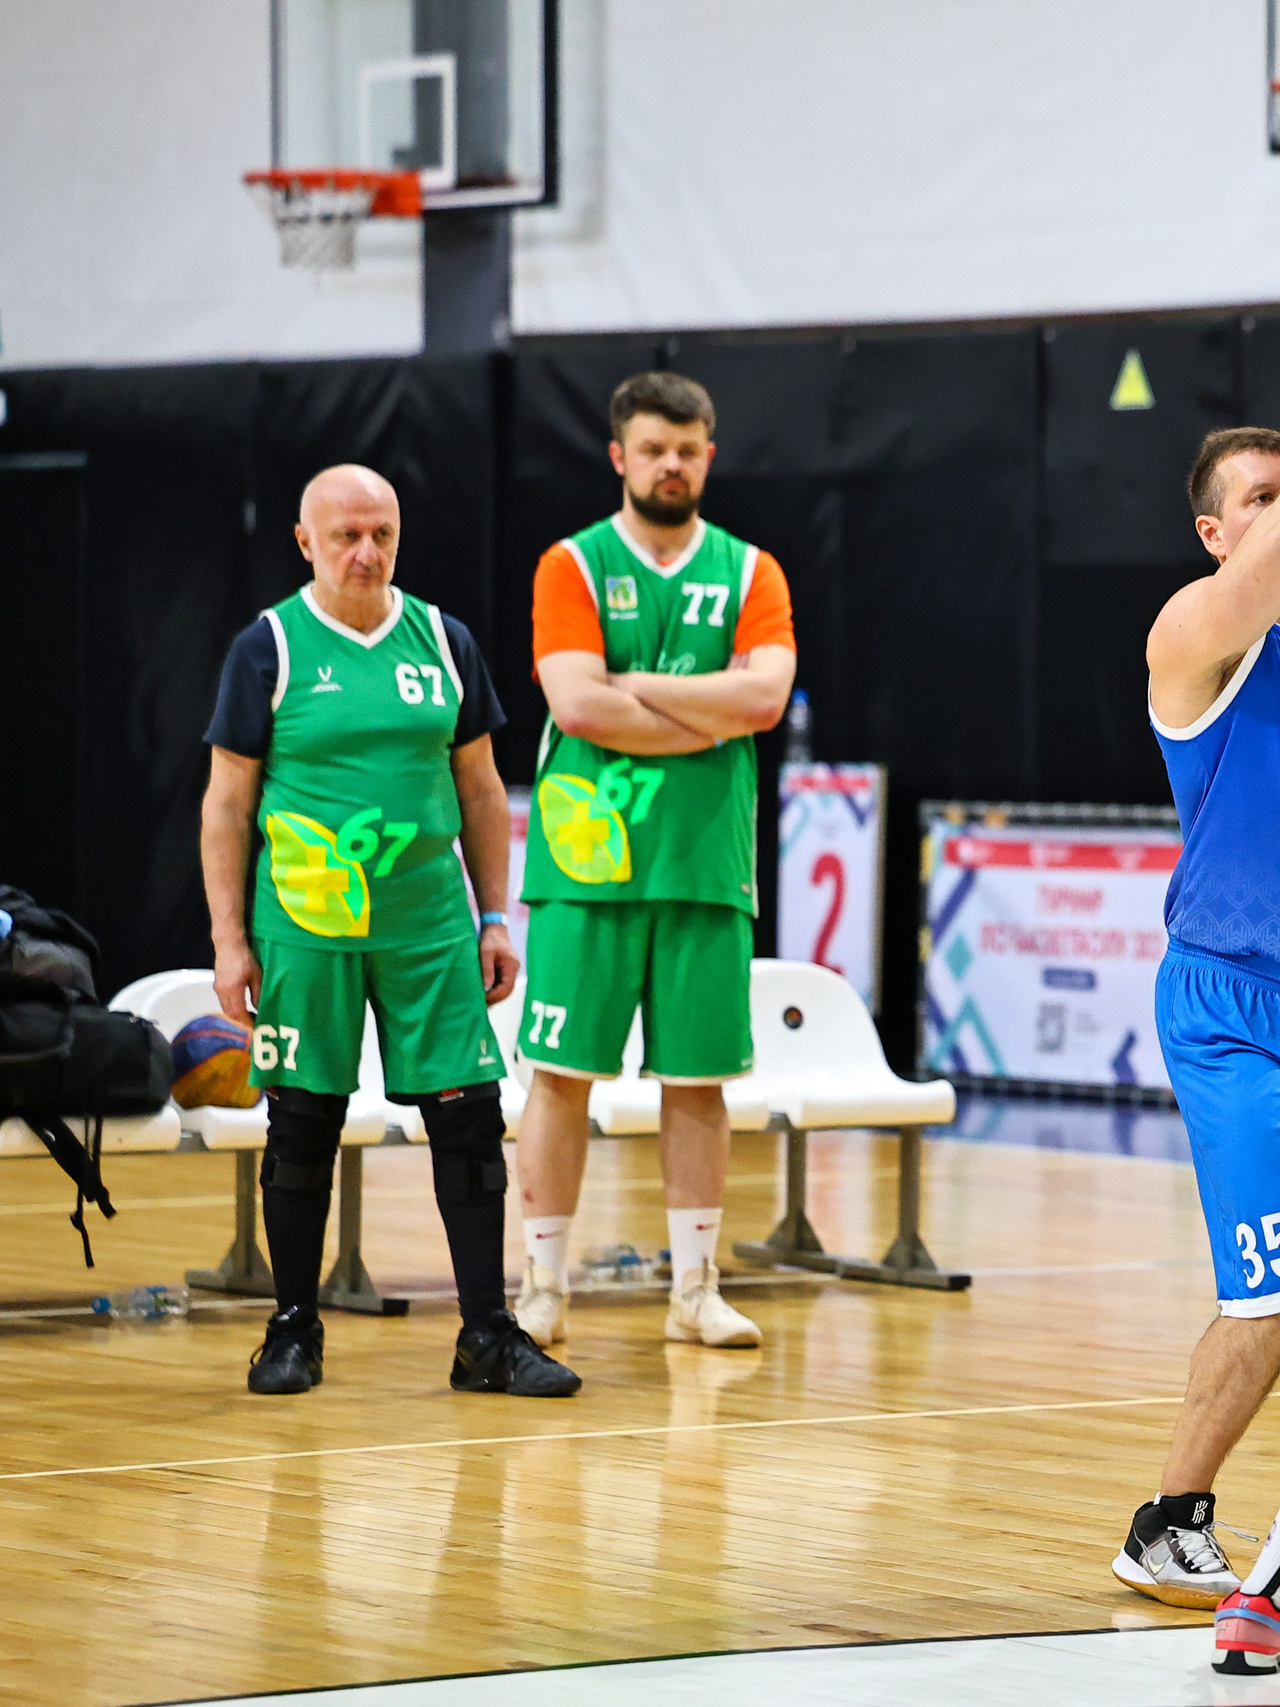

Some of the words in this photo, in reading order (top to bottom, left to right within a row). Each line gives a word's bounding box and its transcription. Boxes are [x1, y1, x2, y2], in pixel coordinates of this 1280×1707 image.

[682, 581, 730, 628] 77
[395, 663, 446, 707] 67
[595, 757, 665, 825] 67
[335, 806, 418, 878] 67
[811, 853, 845, 977] 2
[252, 1024, 300, 1071] 67
[528, 1000, 567, 1049] 77
